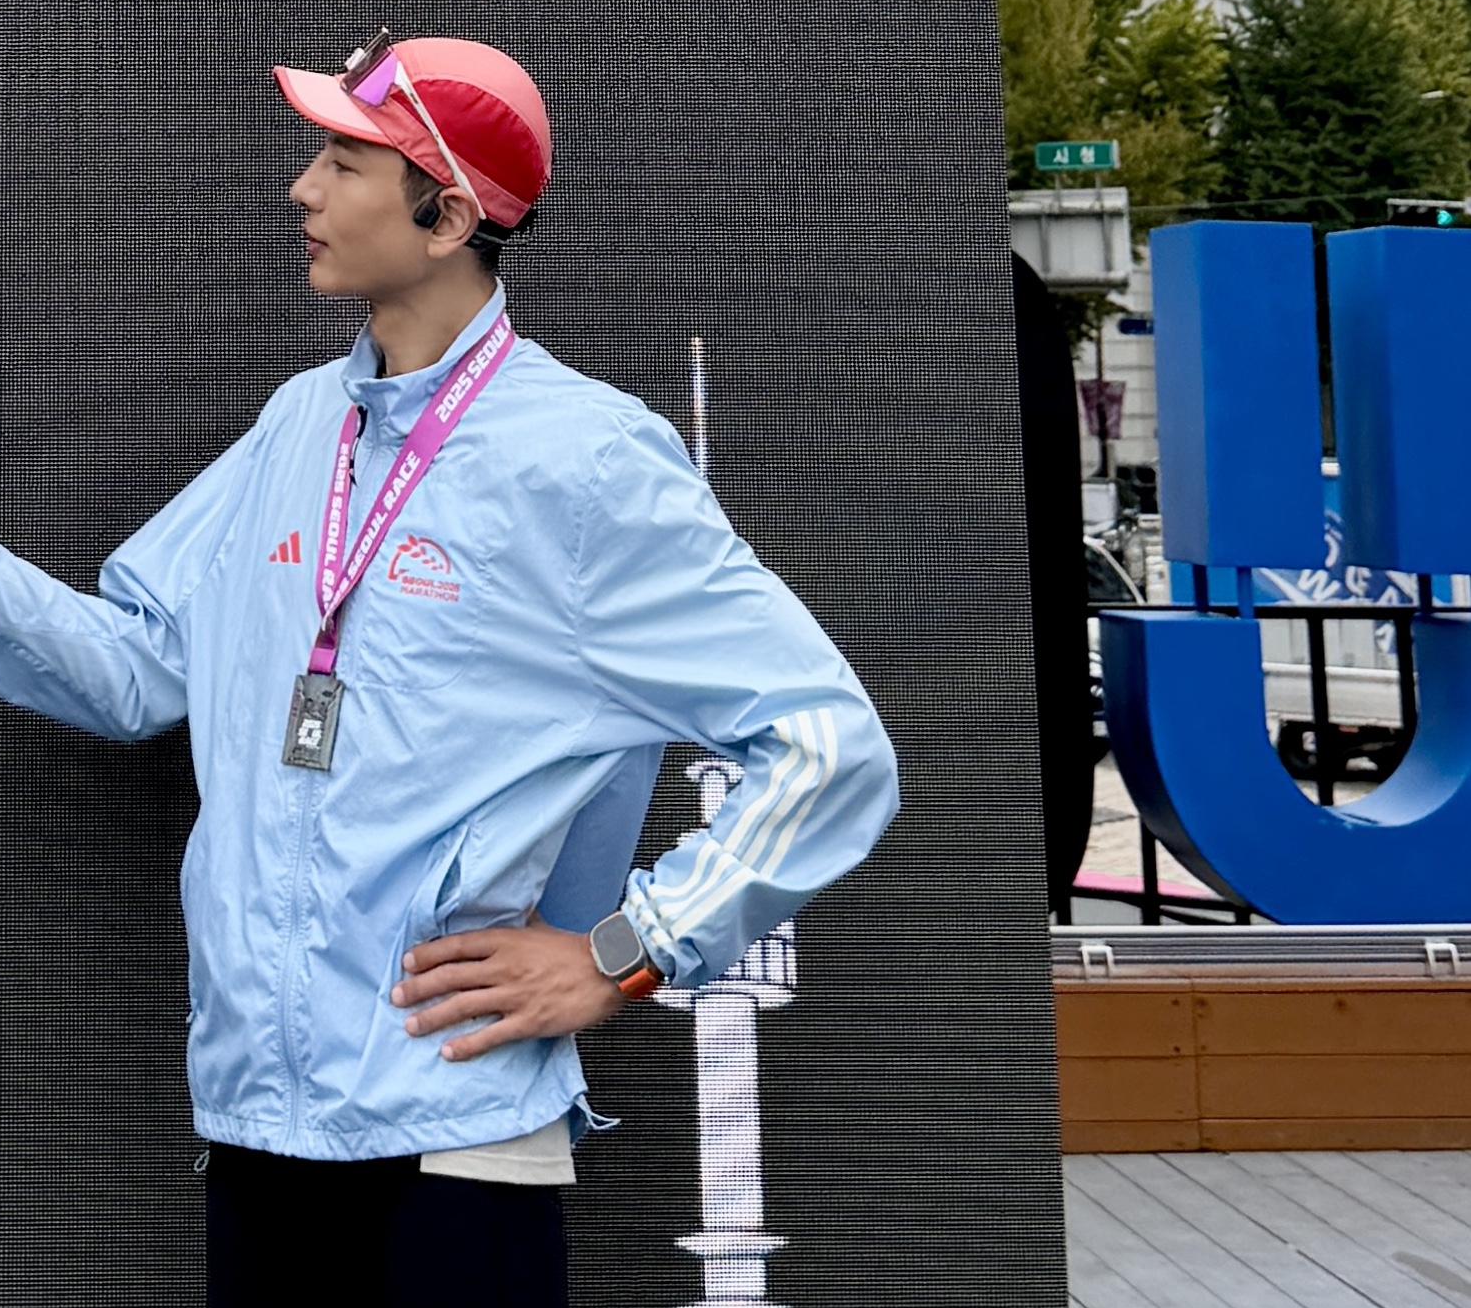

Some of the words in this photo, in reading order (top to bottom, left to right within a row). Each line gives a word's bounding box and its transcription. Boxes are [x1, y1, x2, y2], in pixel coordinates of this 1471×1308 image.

[434, 372, 473, 423] 2025
[467, 323, 509, 380] SEOUL
[324, 495, 343, 567] SEOUL
[347, 511, 388, 581] SEOUL
[382, 450, 421, 511] RACE
